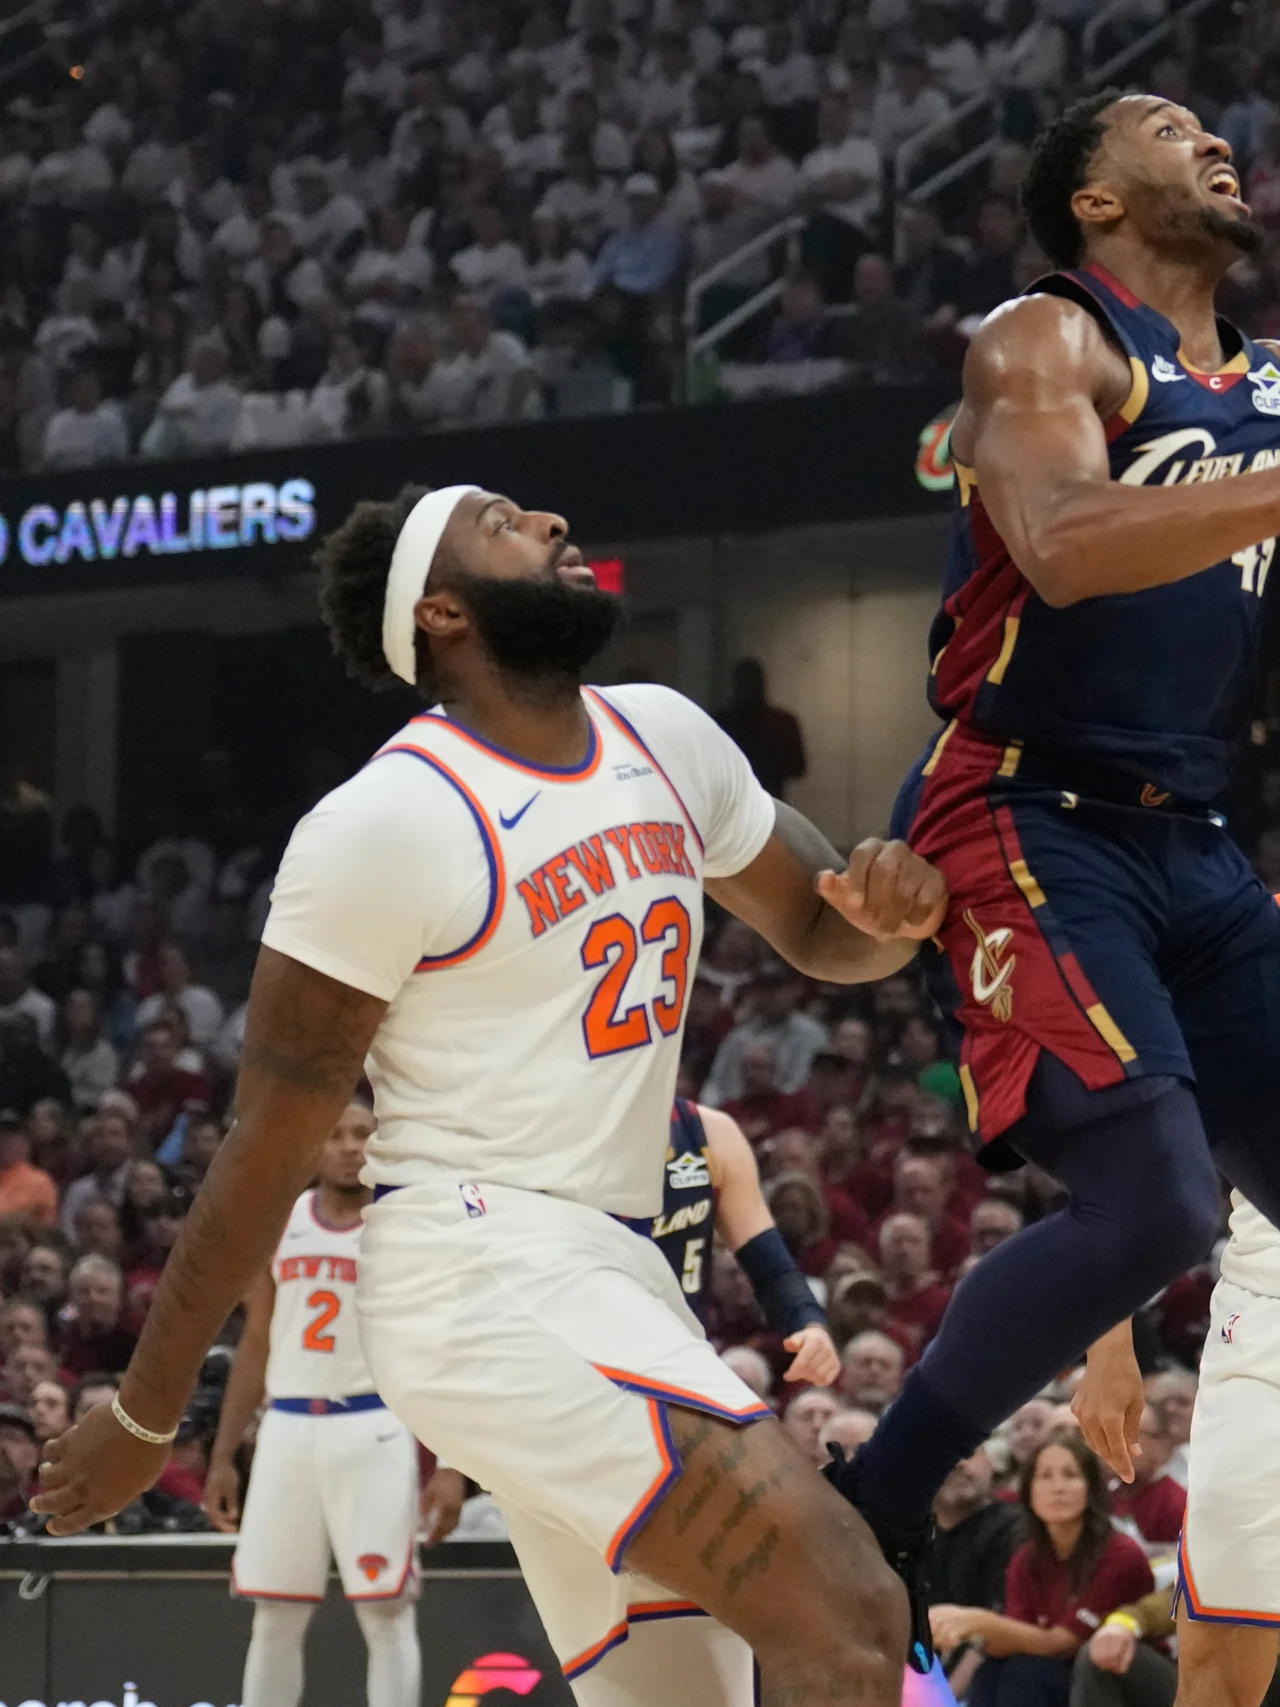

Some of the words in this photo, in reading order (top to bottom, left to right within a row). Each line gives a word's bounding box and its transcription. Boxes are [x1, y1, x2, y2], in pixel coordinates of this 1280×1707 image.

[17, 477, 315, 567] CAVALIERS
[515, 832, 617, 939] NEW
[603, 820, 698, 882] YORK
[580, 895, 692, 1061] 23
[650, 1199, 712, 1240] LAND
[681, 1238, 706, 1294] 5
[302, 1289, 341, 1353] 2
